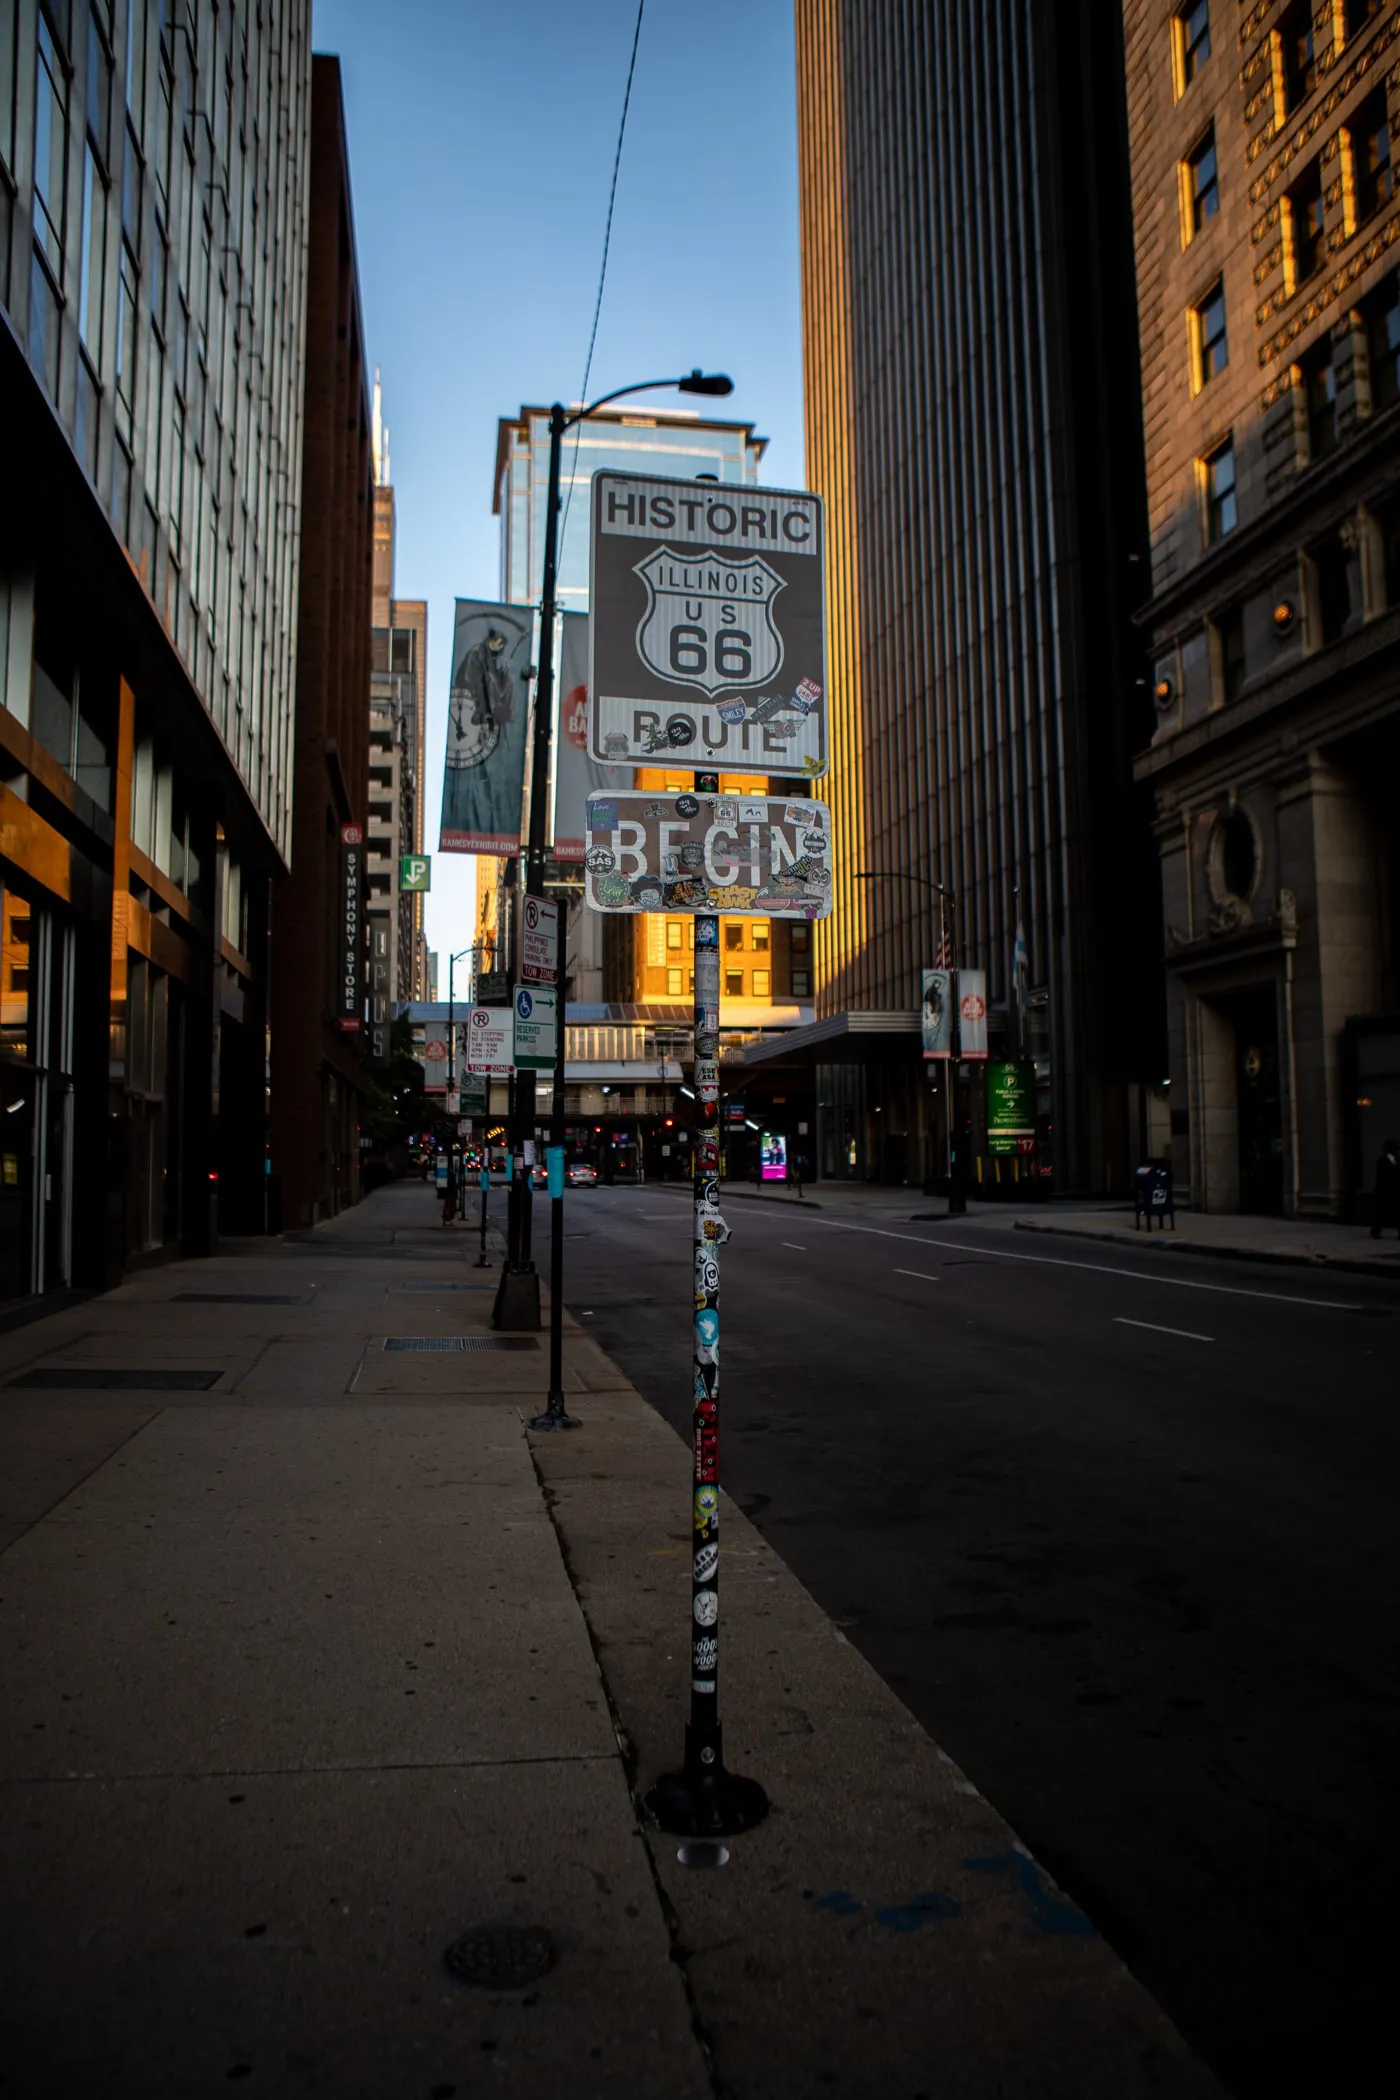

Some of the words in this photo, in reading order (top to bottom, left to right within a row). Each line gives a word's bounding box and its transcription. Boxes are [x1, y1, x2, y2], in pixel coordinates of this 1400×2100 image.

[608, 491, 811, 543] HISTORIC
[659, 566, 764, 596] ILLINOIS
[669, 625, 752, 679] 66
[634, 710, 787, 753] ROUTE
[721, 707, 745, 719] SMILEY
[588, 856, 612, 866] SAS
[612, 820, 805, 888] BEGIN
[345, 853, 356, 946] SYMPHONY
[345, 951, 356, 1010] STORE
[525, 965, 538, 977] TOW
[539, 968, 555, 981] ZONE
[516, 1025, 540, 1035] RESERVED
